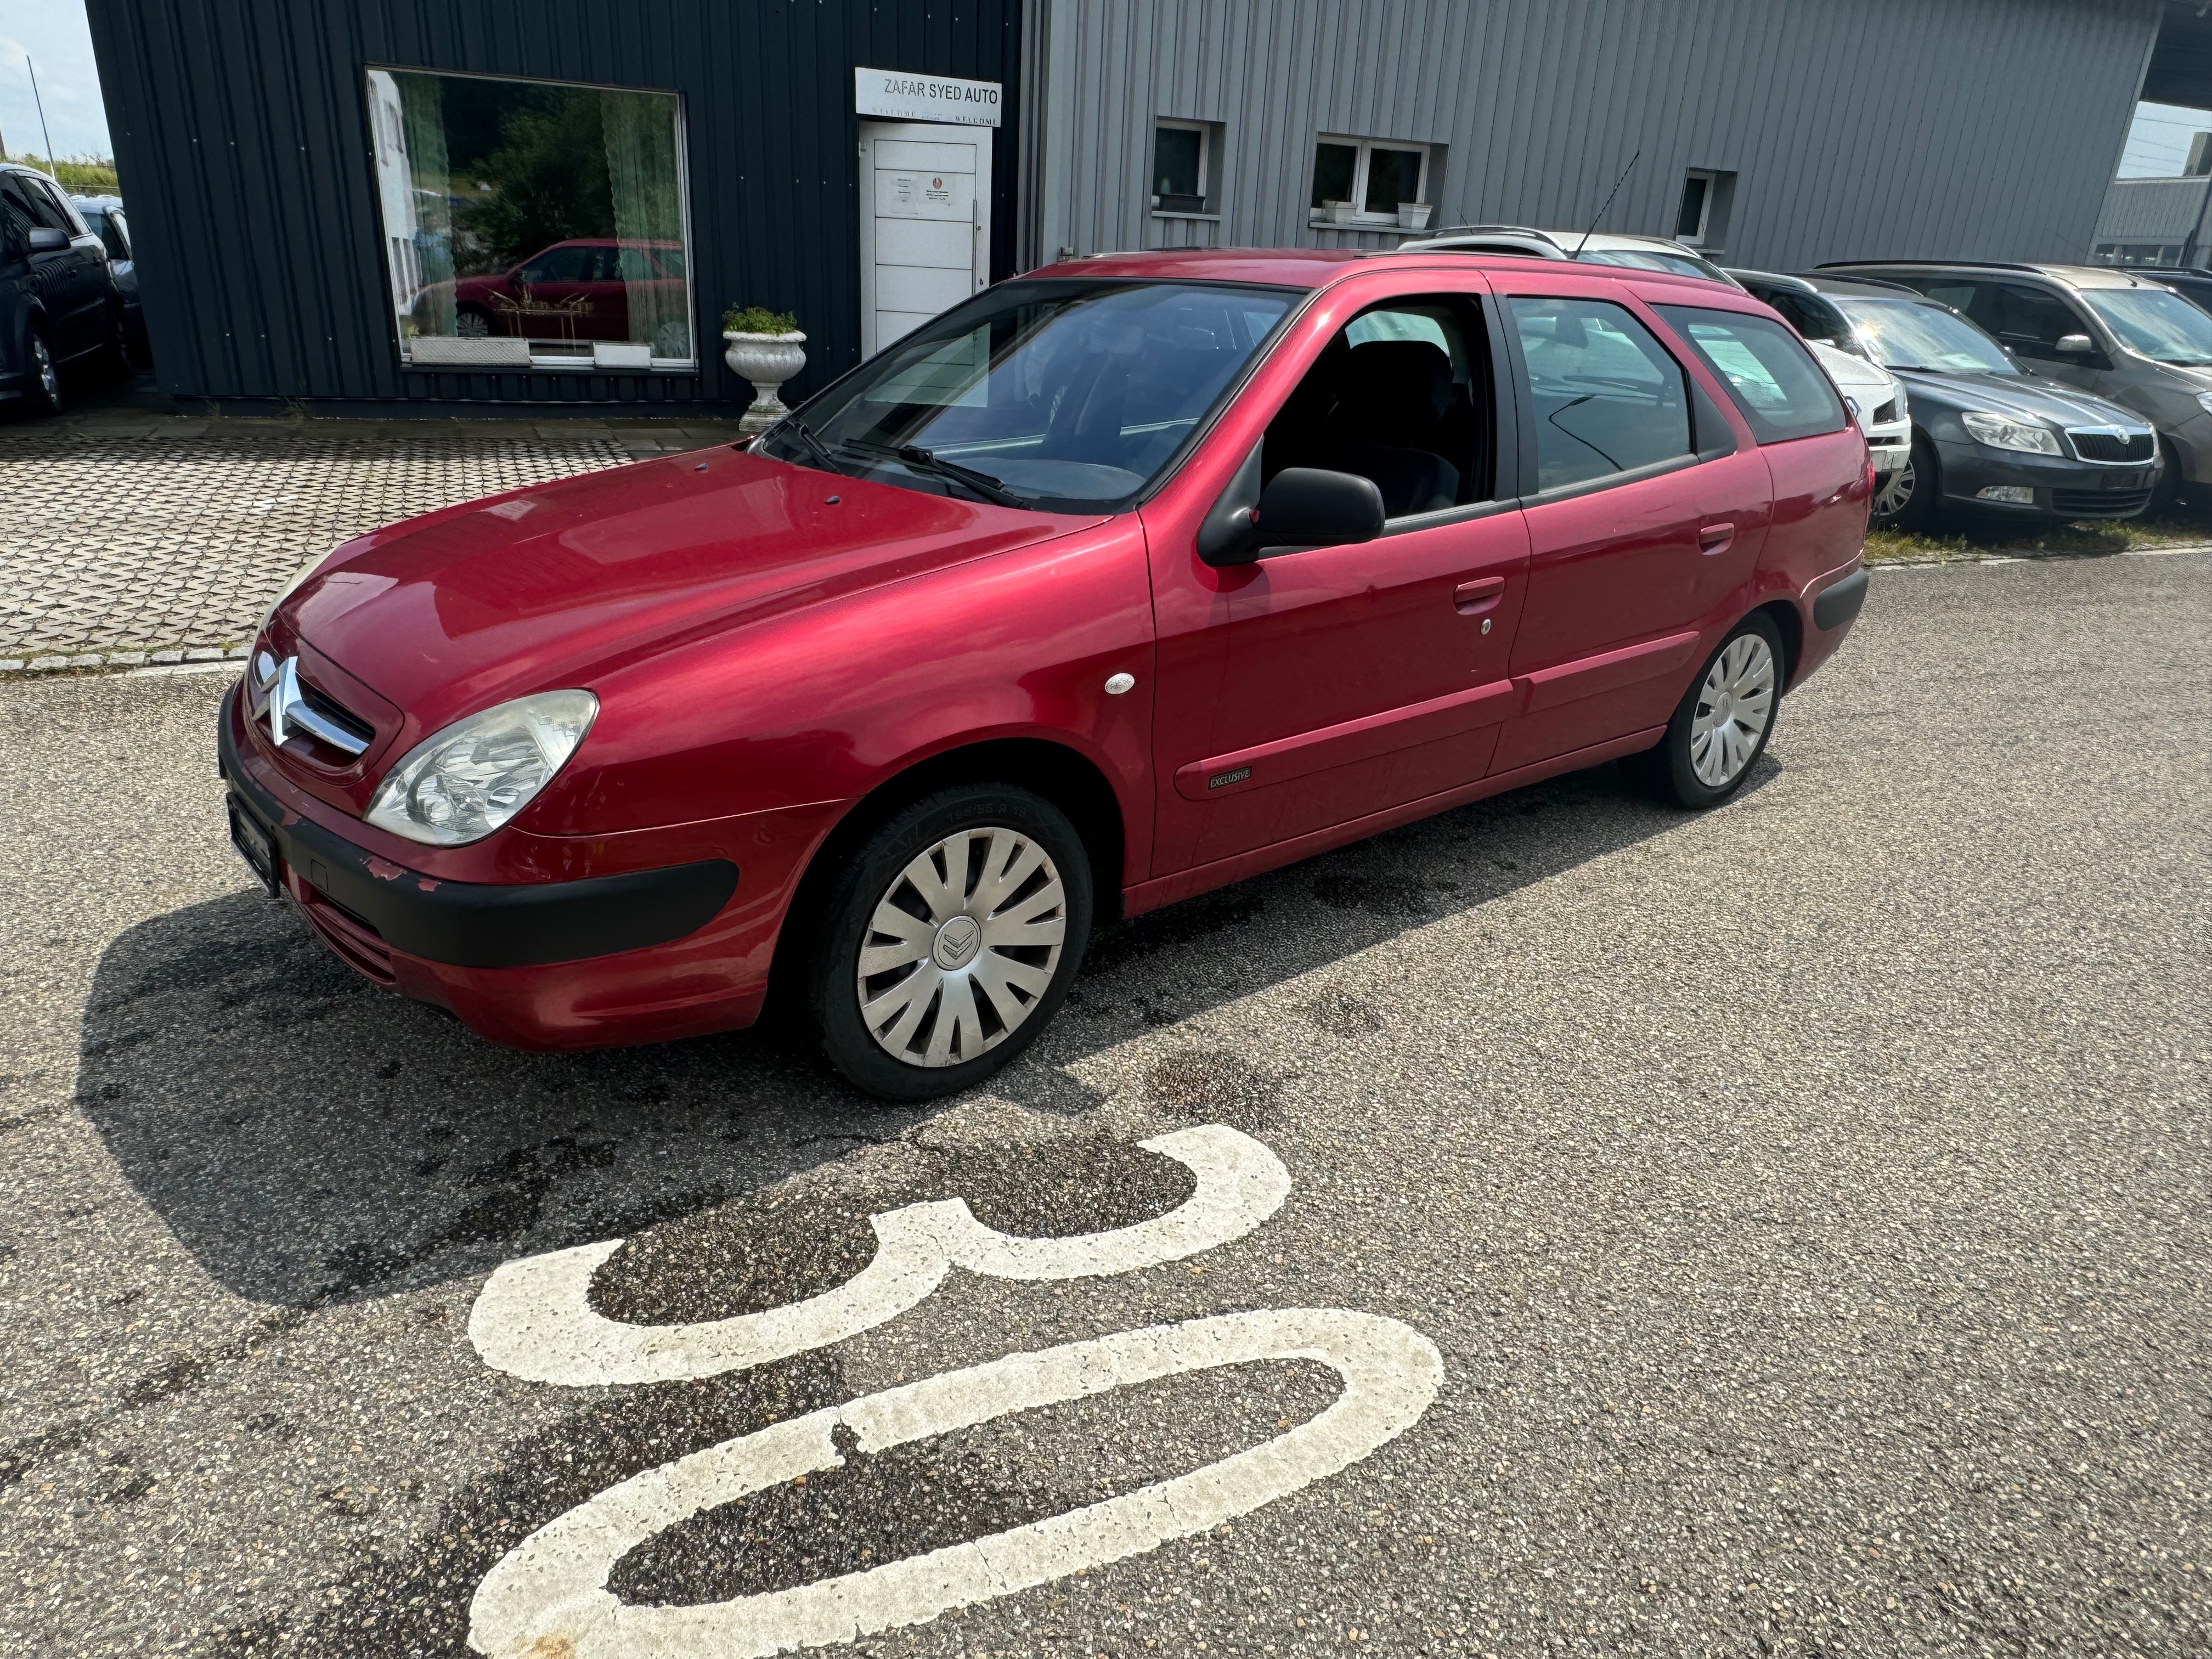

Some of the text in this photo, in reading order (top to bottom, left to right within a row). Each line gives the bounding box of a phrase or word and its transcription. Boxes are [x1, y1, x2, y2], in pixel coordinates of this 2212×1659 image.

[884, 78, 998, 104] ZAFAR SYED AUTO
[1210, 769, 1249, 788] EXCLUSIVE
[469, 1124, 1445, 1659] 30
